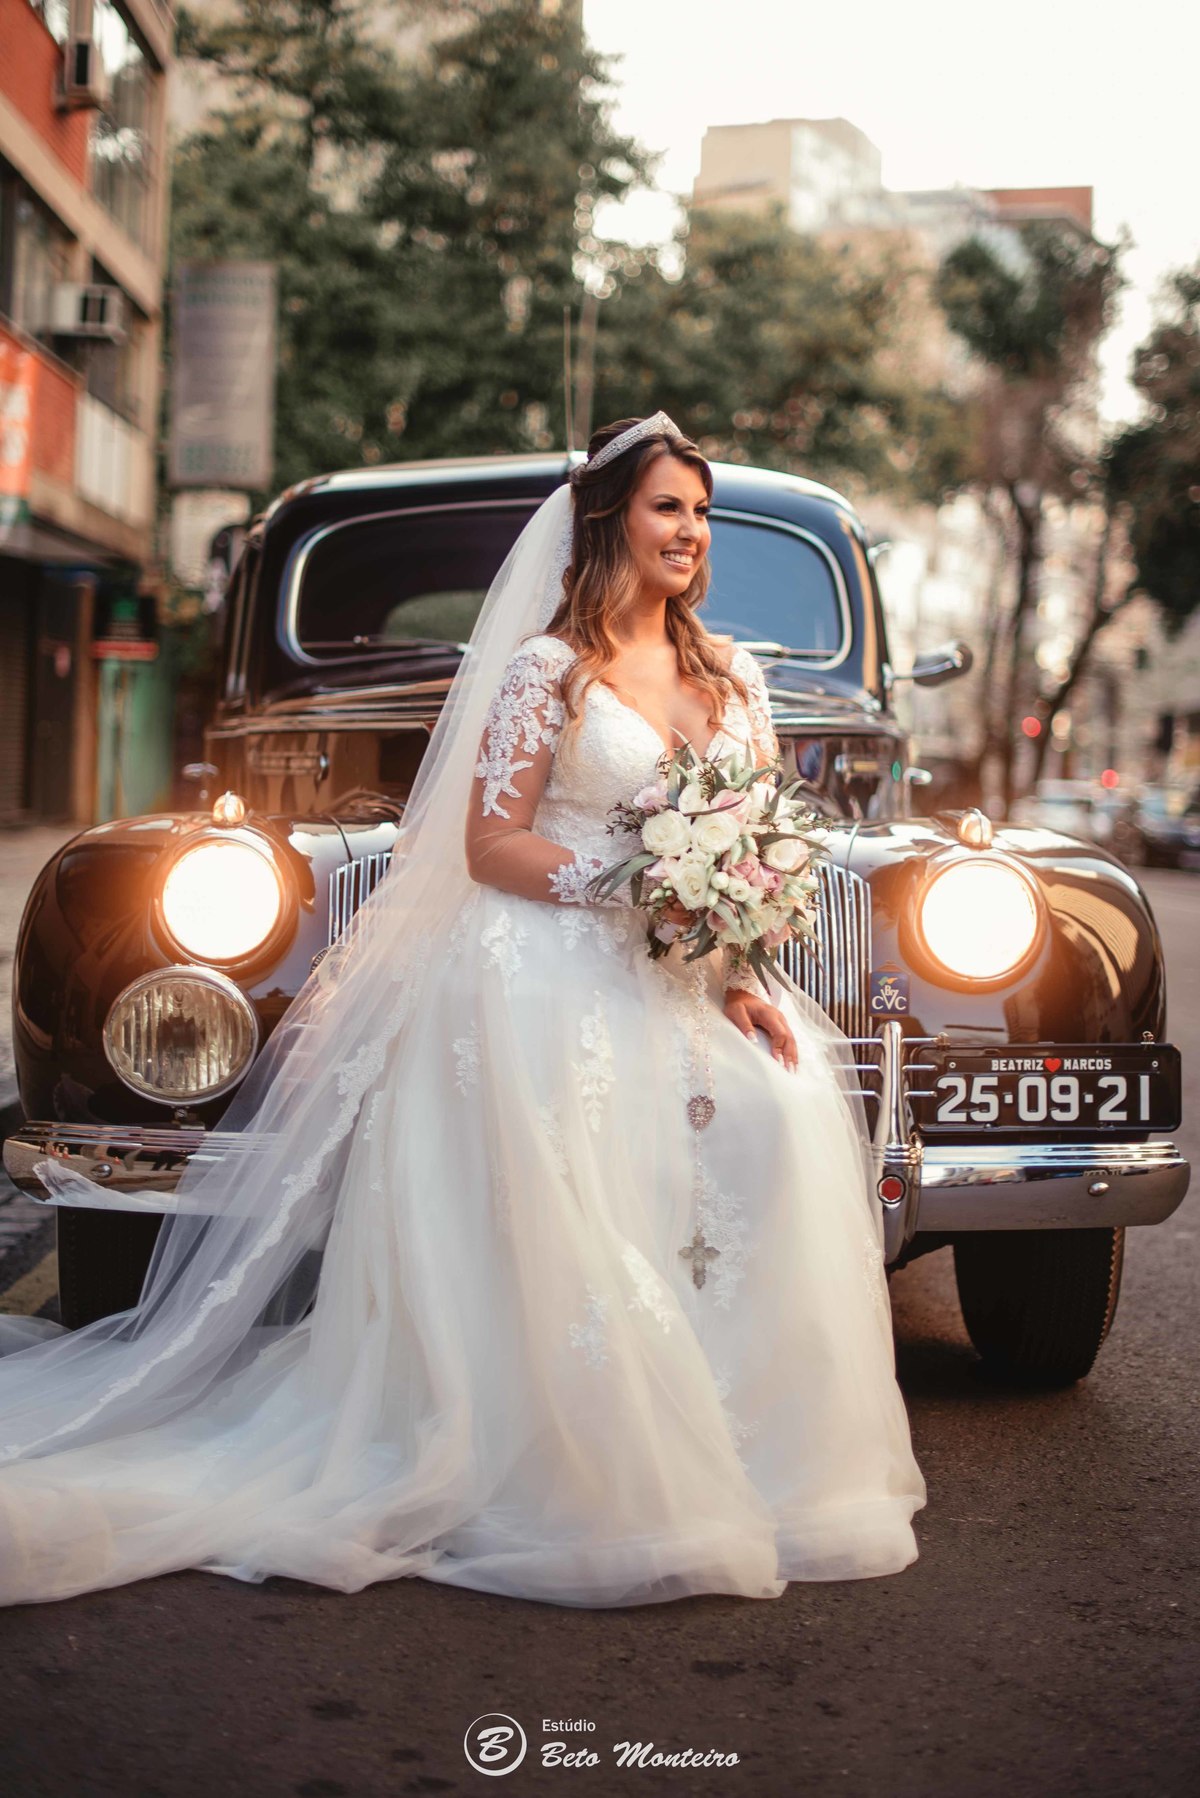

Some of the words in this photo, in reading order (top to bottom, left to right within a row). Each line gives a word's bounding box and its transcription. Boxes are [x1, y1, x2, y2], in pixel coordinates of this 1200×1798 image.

[871, 989, 907, 1010] CVC
[991, 1059, 1044, 1071] BEATRIZ
[1063, 1058, 1112, 1071] MARCOS
